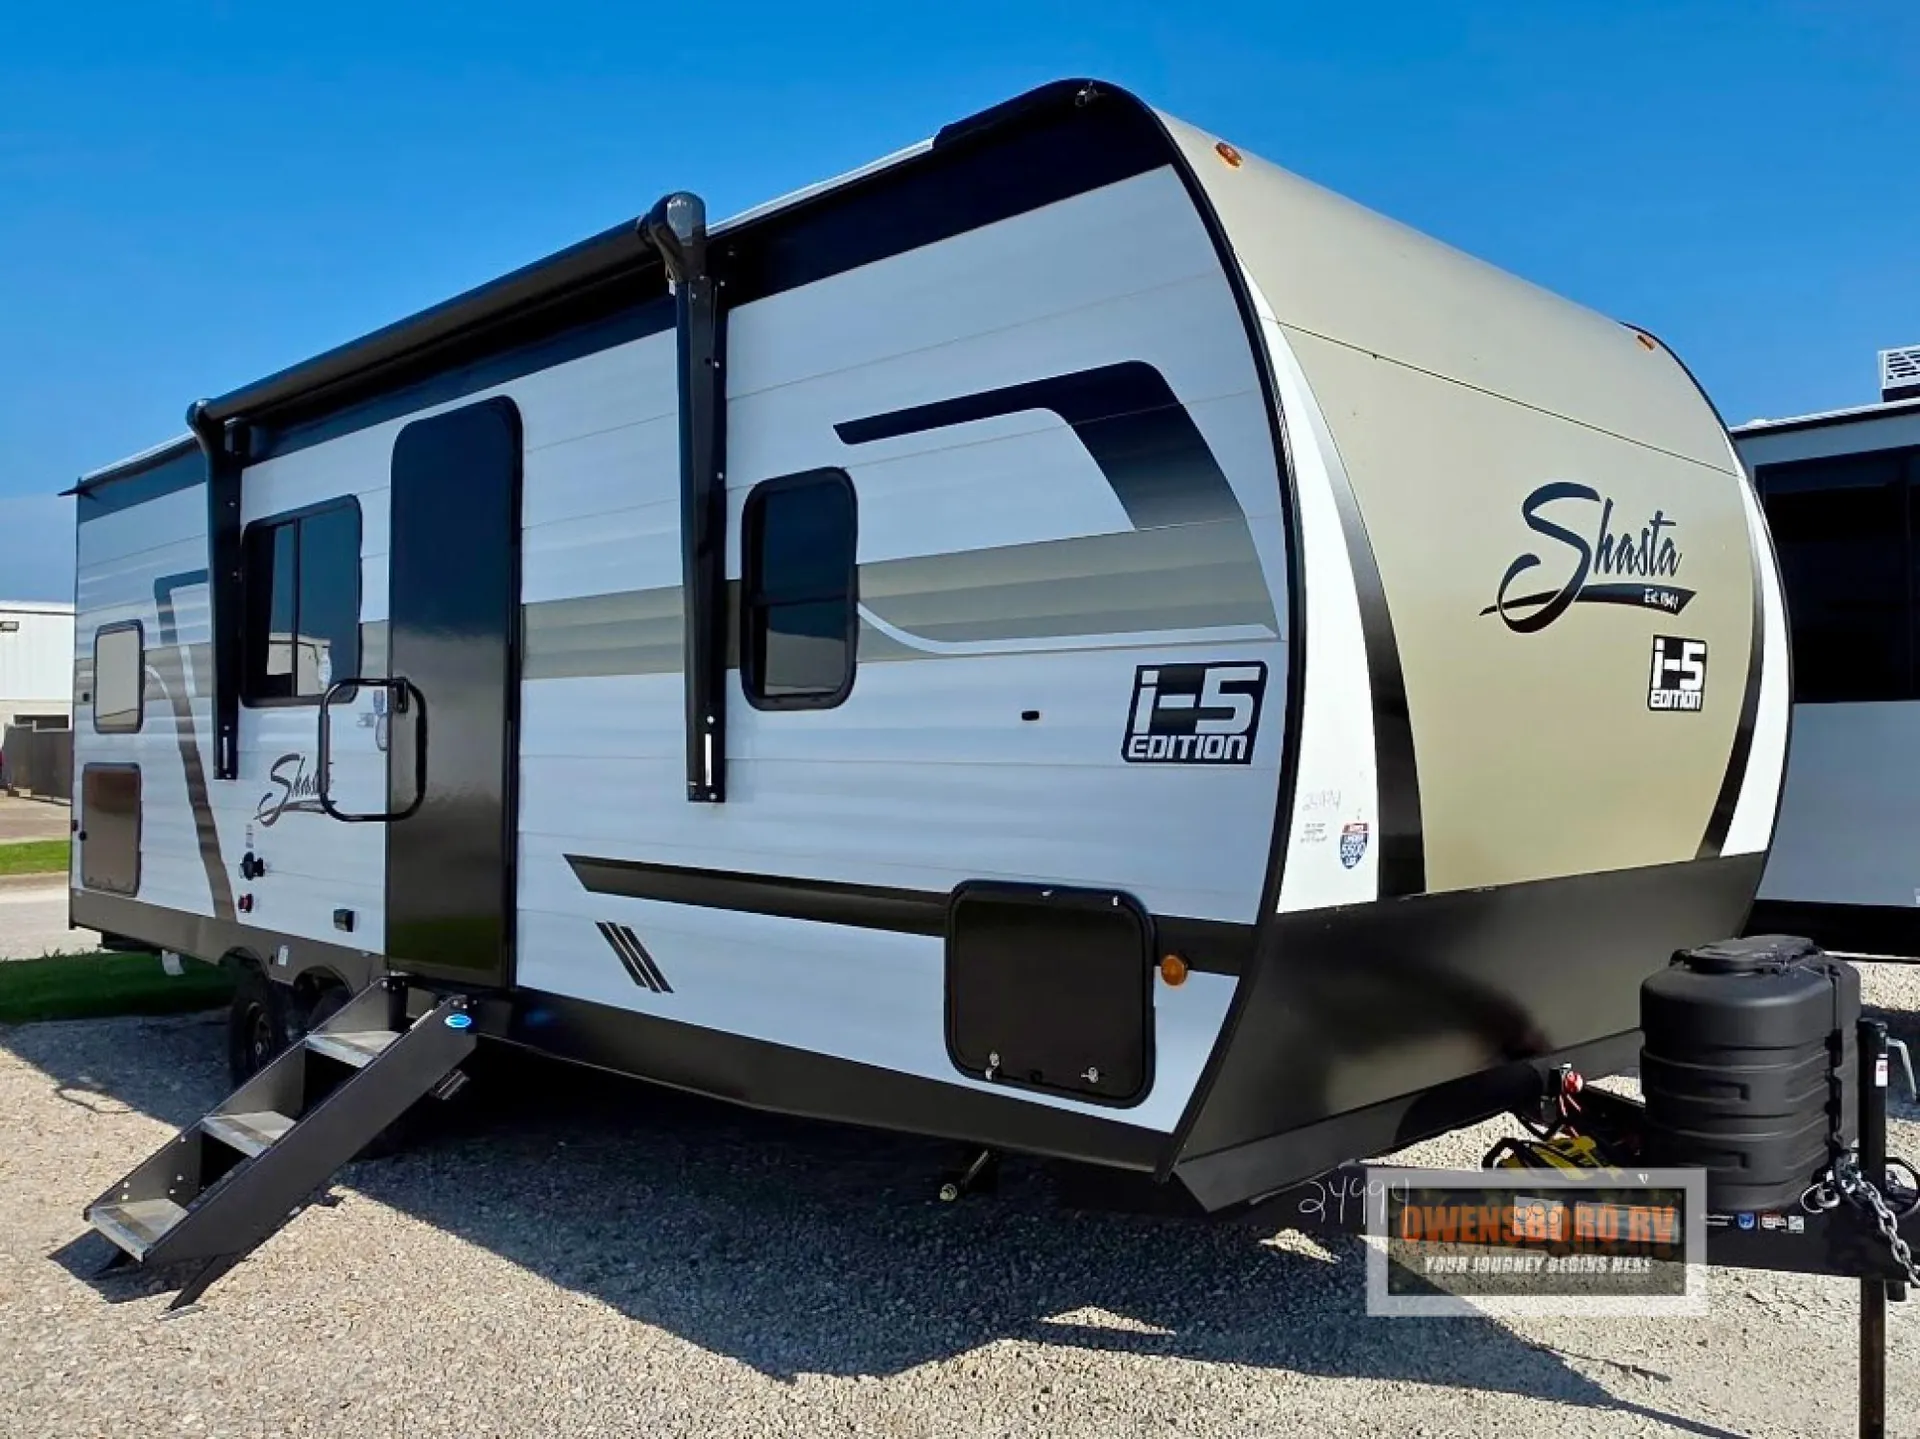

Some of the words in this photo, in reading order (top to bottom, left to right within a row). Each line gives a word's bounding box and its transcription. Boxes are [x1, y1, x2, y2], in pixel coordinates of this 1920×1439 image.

[1494, 482, 1683, 633] Shasta
[1652, 638, 1706, 690] i-5
[1132, 667, 1262, 734] i-5
[1650, 690, 1702, 709] EDITION
[1128, 734, 1248, 760] EDITION
